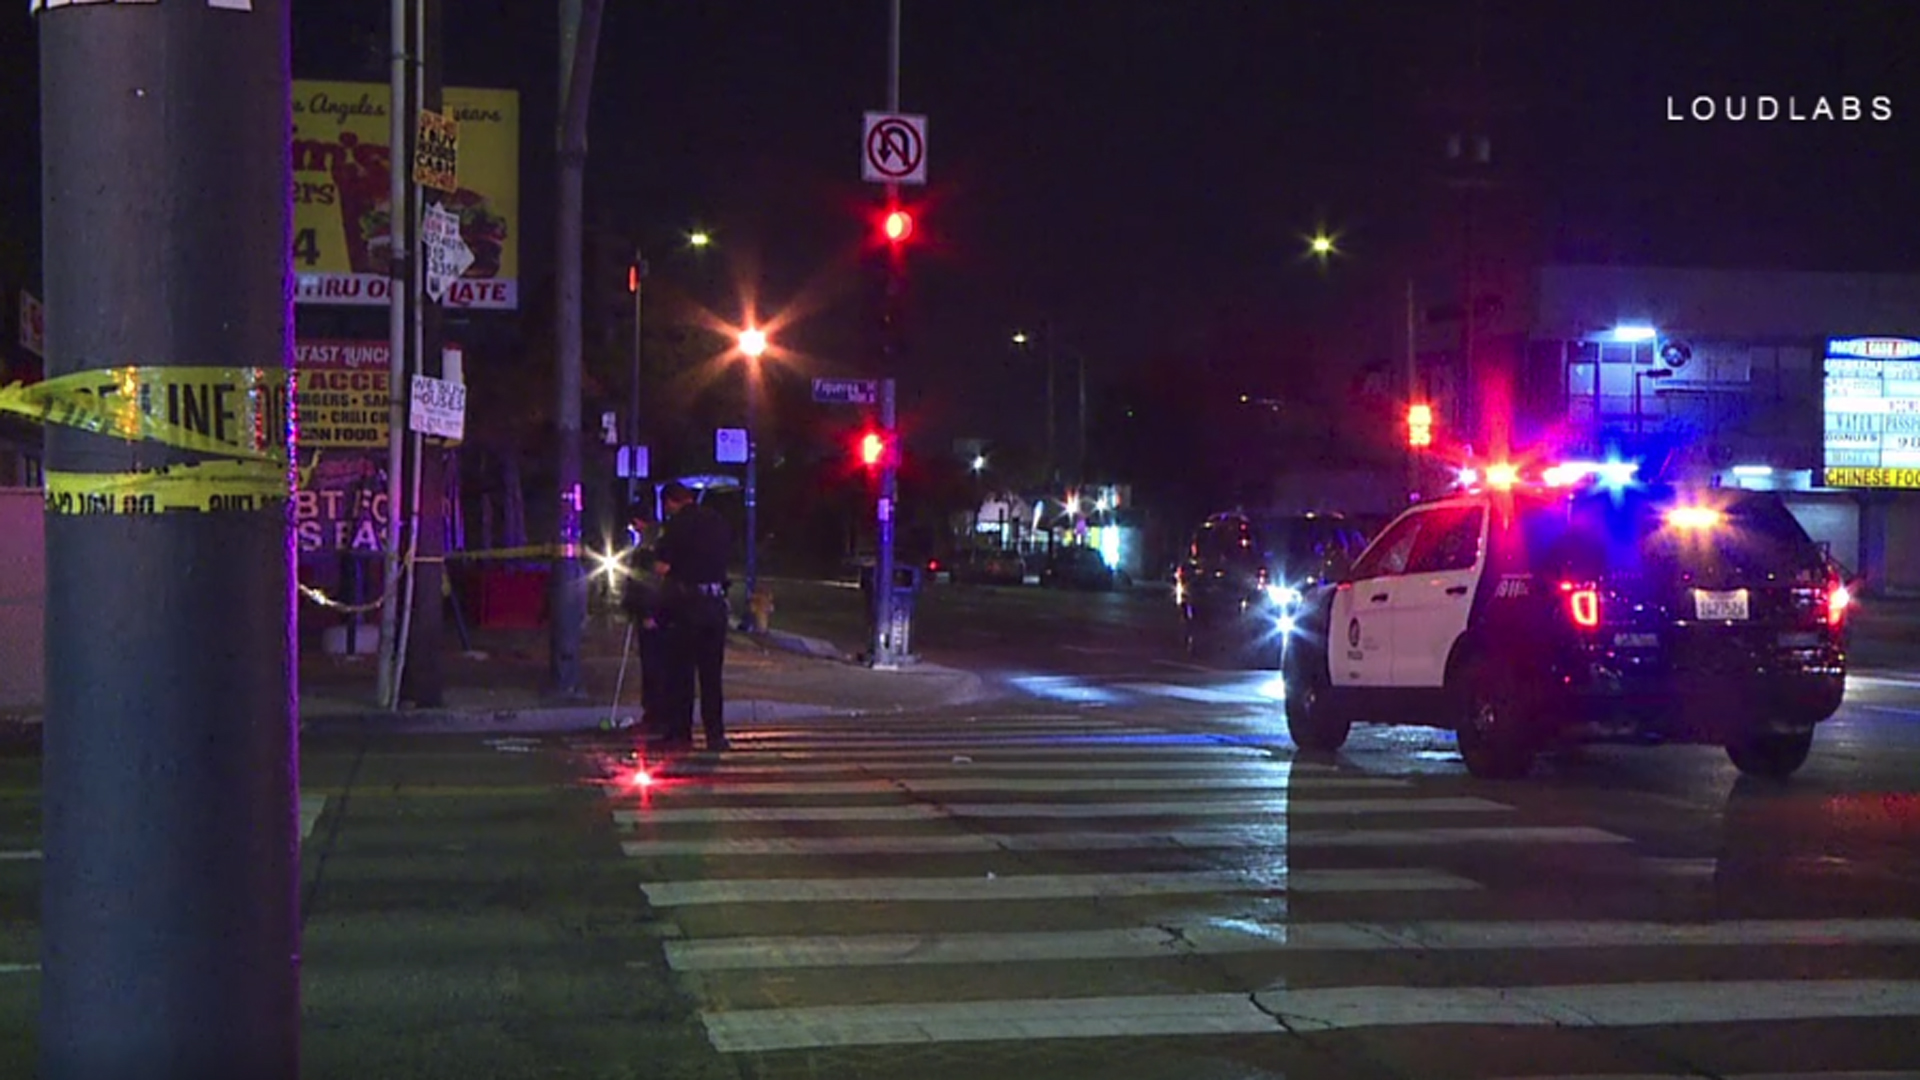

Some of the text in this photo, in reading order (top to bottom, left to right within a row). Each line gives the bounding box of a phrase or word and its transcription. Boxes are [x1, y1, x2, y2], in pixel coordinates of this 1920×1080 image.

[310, 92, 385, 124] Angeles
[450, 282, 507, 306] LATE
[334, 428, 379, 441] FOOD
[1826, 468, 1890, 486] CHINESE
